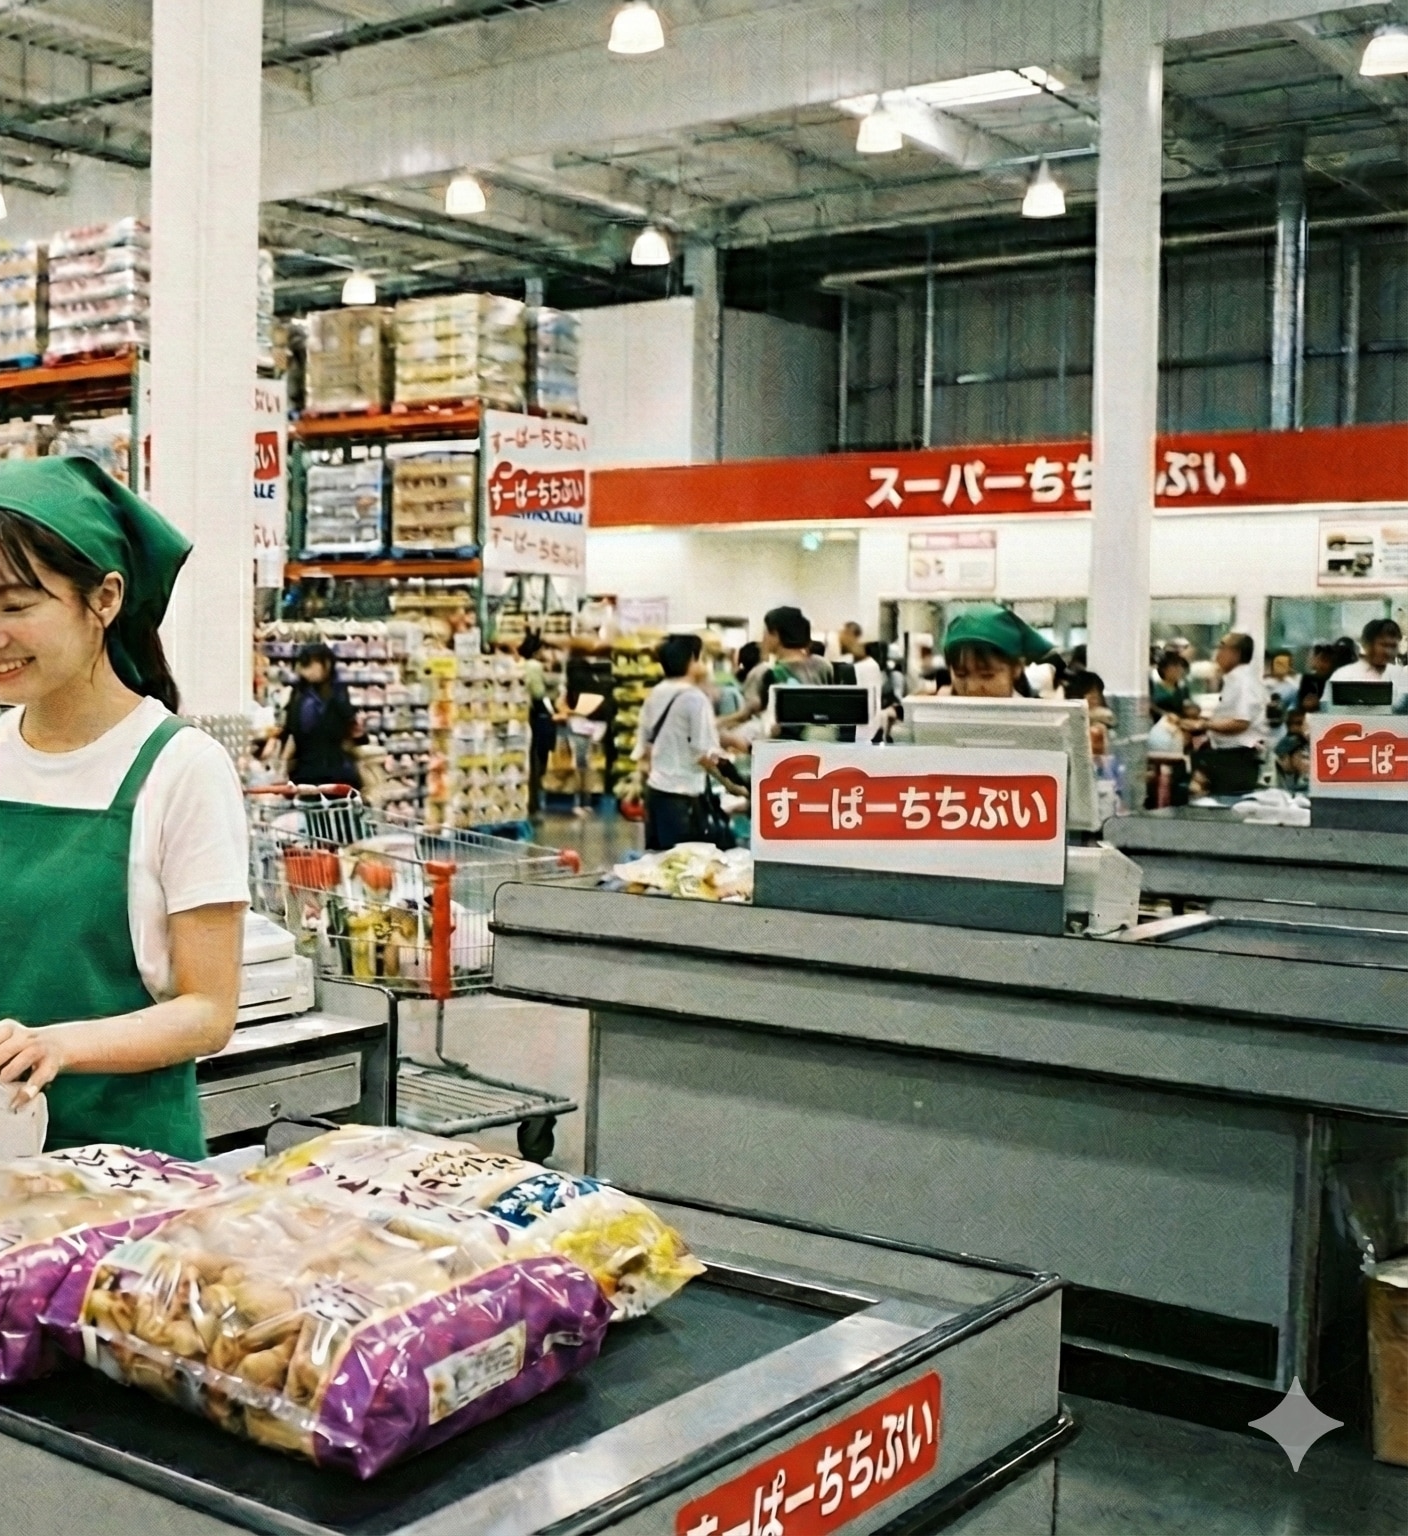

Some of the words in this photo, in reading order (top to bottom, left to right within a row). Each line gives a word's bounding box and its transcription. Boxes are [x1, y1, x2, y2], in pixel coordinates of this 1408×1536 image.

[767, 785, 1048, 830] すーぱーちちぷい
